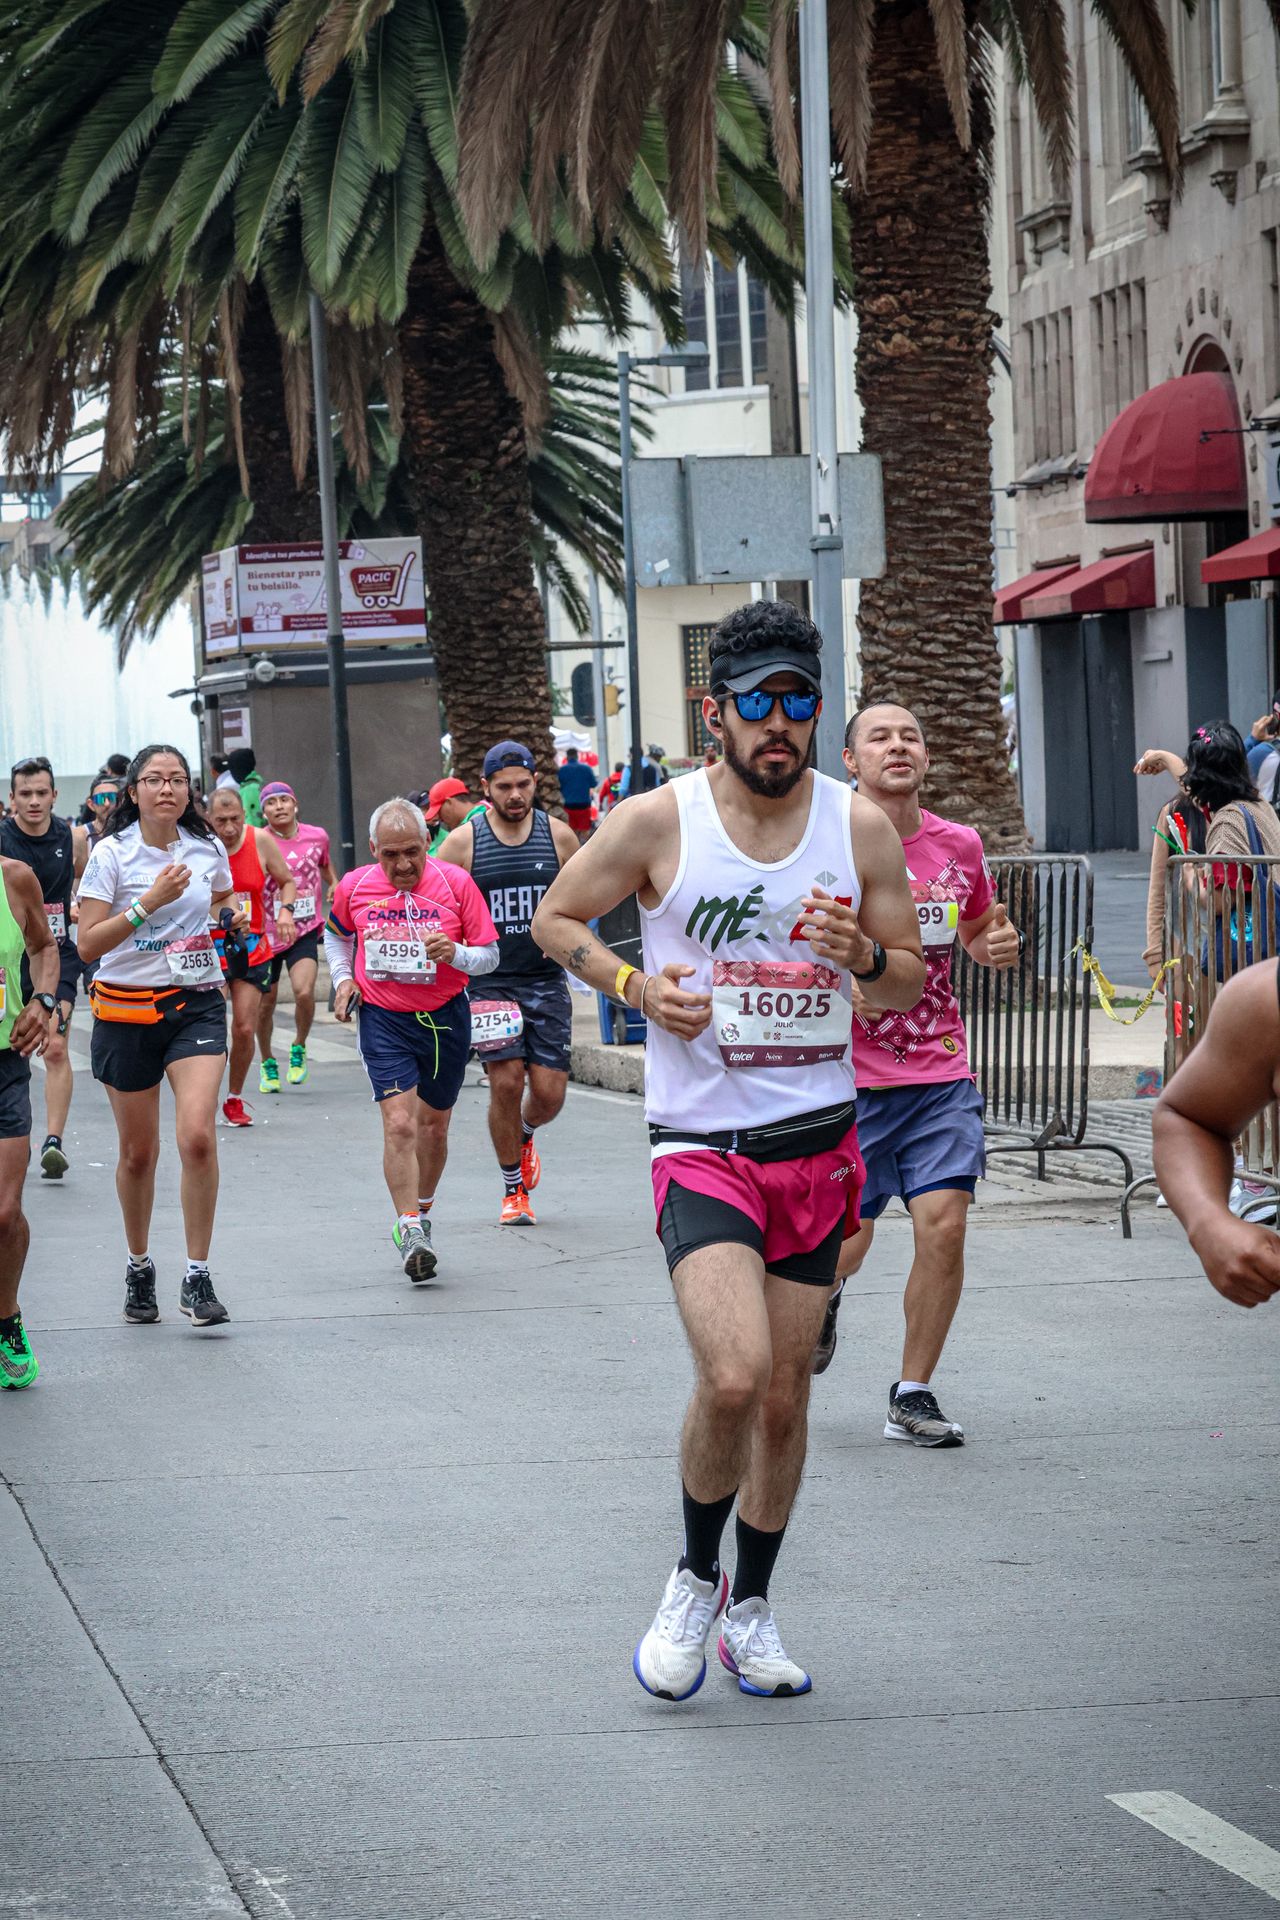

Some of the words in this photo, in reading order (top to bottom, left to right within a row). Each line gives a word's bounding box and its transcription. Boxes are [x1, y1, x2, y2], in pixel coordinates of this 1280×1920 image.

[247, 571, 296, 580] Bienestar
[298, 570, 321, 579] para
[357, 572, 391, 584] PACIC
[261, 581, 302, 591] bolsillo.
[367, 909, 440, 921] CARRERA
[918, 906, 943, 925] 99
[379, 943, 419, 957] 4596
[738, 991, 831, 1018] 16025
[471, 1013, 511, 1030] 2754
[729, 1051, 755, 1061] telcel
